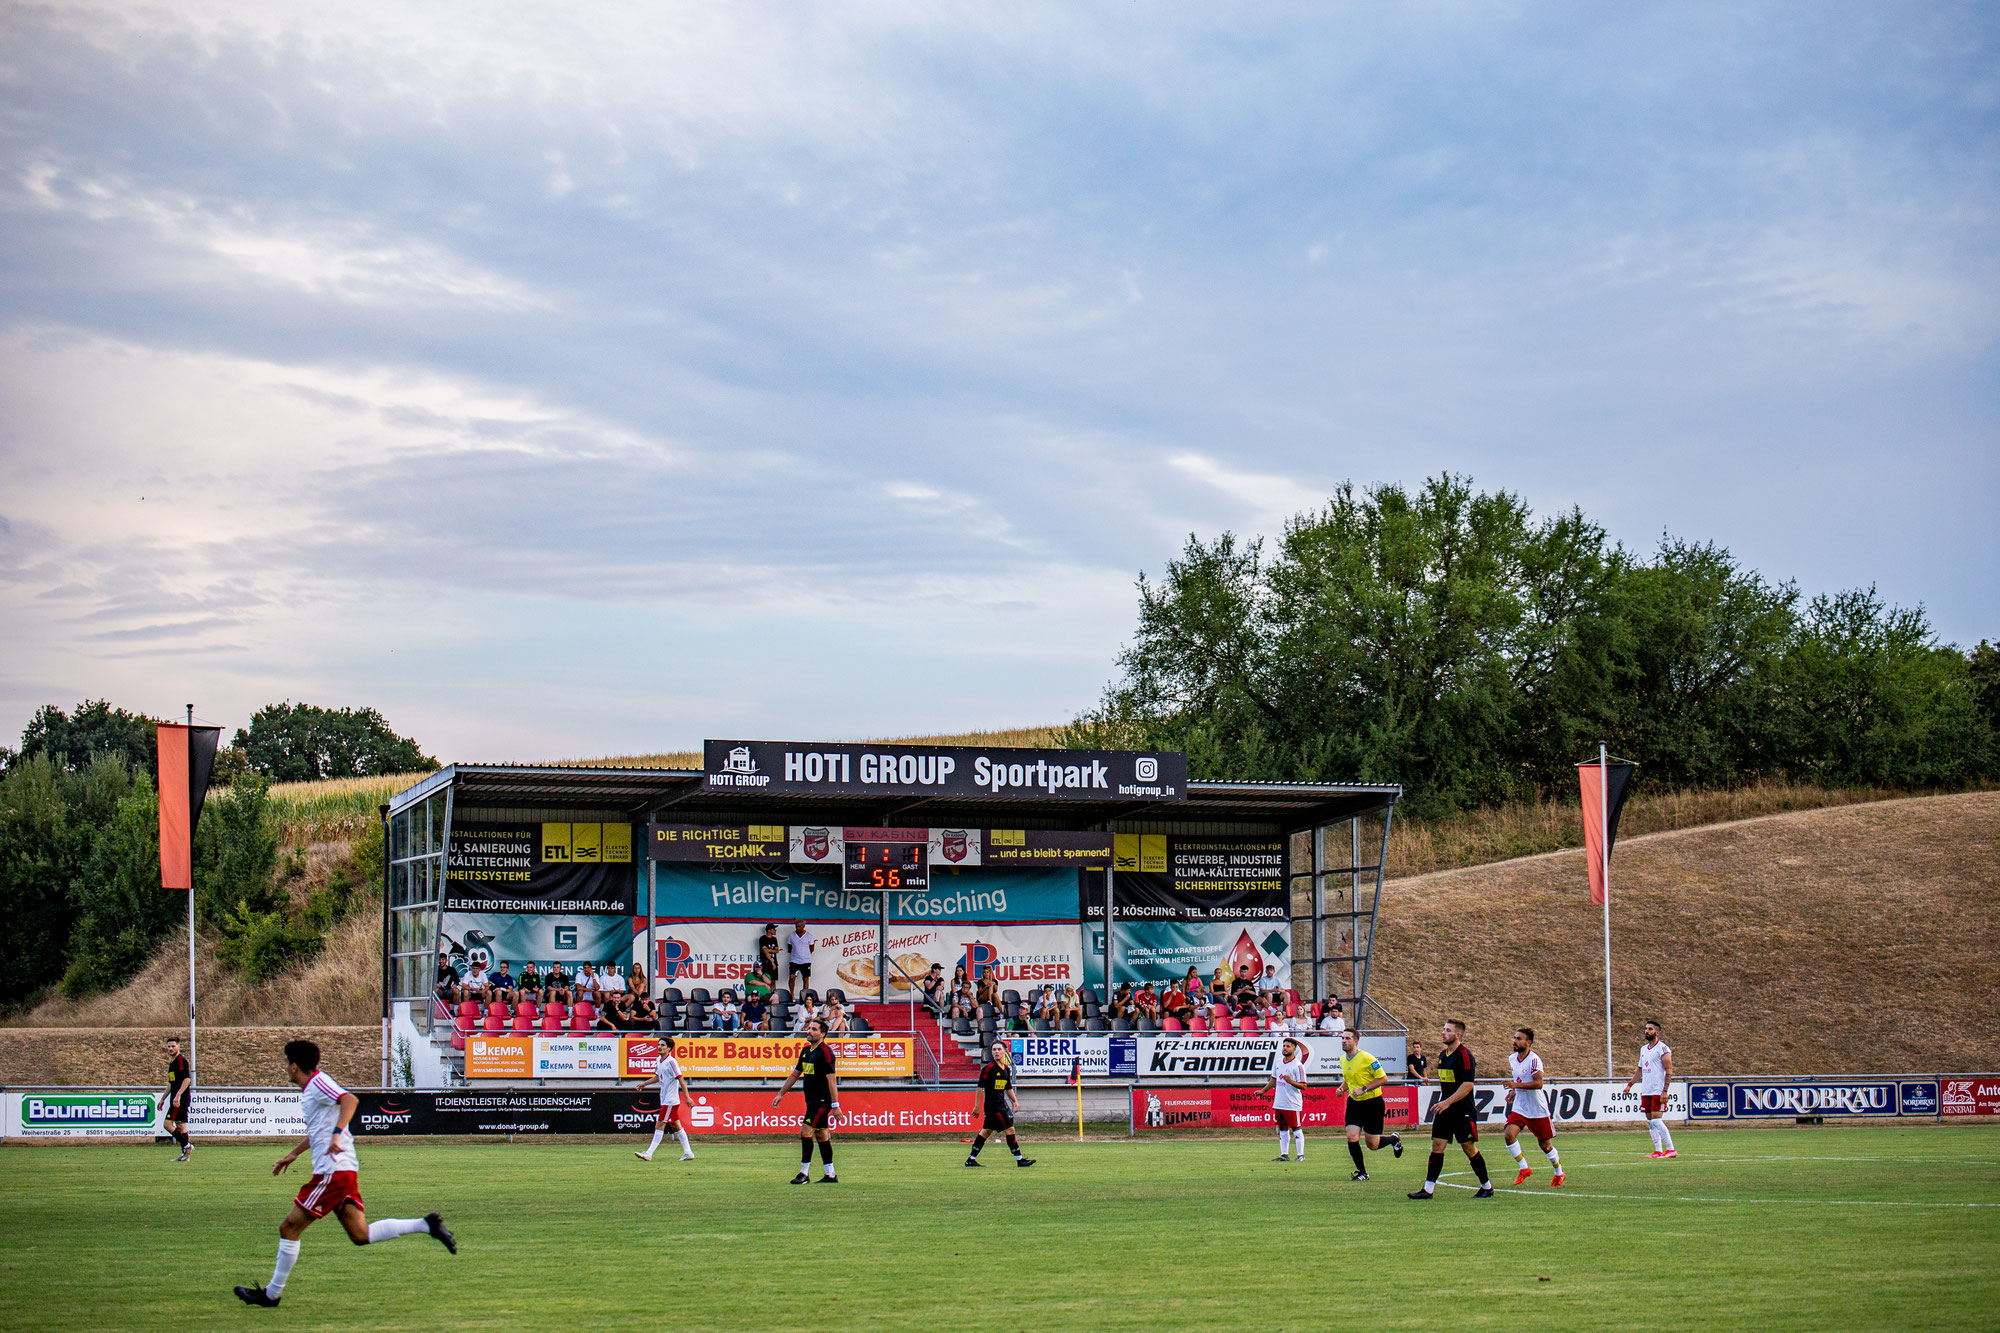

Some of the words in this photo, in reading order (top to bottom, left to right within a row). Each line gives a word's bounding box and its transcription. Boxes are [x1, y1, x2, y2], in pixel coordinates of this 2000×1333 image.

[785, 752, 849, 782] HOTI
[860, 754, 955, 784] GROUP
[974, 756, 1108, 793] Sportpark
[710, 774, 733, 785] HOTI
[736, 775, 769, 786] GROUP
[1119, 784, 1174, 796] hotigroup_in
[657, 830, 677, 840] DIE
[683, 830, 740, 840] RICHTIGE
[846, 830, 864, 838] SV
[872, 831, 927, 839] KASING
[464, 843, 531, 854] SANIERUNG
[544, 845, 569, 859] ETL
[706, 844, 765, 858] TECHNIK
[1000, 849, 1017, 858] und
[1020, 850, 1032, 858] es
[1034, 848, 1061, 858] bleibt
[1064, 848, 1110, 859] spannend!
[861, 847, 865, 862] 1
[914, 848, 918, 863] 1
[1175, 855, 1227, 866] GEWERBE,
[1230, 855, 1281, 864] INDUSTRIE
[873, 869, 900, 887] 56
[907, 877, 925, 885] min
[1175, 867, 1281, 877] KLIMA-KÄLTETECHNIK
[1175, 881, 1281, 890] SICHERHEITSSYSTEME
[898, 889, 1007, 916] Kösching
[1087, 907, 1119, 916] 8502
[1122, 905, 1176, 917] KÖSCHING
[1185, 908, 1206, 917] TEL.
[1210, 908, 1284, 917] 08456-278020
[822, 937, 839, 948] DAS
[842, 929, 875, 943] LEBEN
[842, 942, 879, 958] BESSER
[888, 934, 930, 949] CHMECKT
[1127, 948, 1157, 956] HEIZÖLE
[1175, 945, 1222, 954] KRAFTSTOFFE
[655, 939, 752, 979] PAULESE
[694, 953, 760, 962] METZGERE
[960, 943, 1069, 982] PULESER
[1002, 955, 1070, 963] METZGEREI
[1171, 955, 1218, 964] HERSTELLER!
[577, 966, 595, 975] SE
[599, 966, 624, 975] MT!
[488, 1047, 524, 1055] KEMPA
[724, 1042, 811, 1059] Baustof
[1027, 1039, 1080, 1055] EBERL
[1155, 1041, 1278, 1050] KFZ-LACKIERUNGEN
[1150, 1052, 1276, 1071] Krammel
[1743, 1087, 1888, 1113] NORDBRÄU
[29, 1100, 148, 1119] Baumeister
[1603, 1105, 1622, 1113] Tel.:
[1677, 1104, 1686, 1112] 25
[361, 1115, 411, 1123] DONAT
[614, 1114, 659, 1122] DONAT
[723, 1111, 804, 1130] Sparkasse
[828, 1110, 895, 1131] golstadt
[900, 1110, 971, 1126] Eichstätt
[1151, 1111, 1211, 1127] HÜLMEYER
